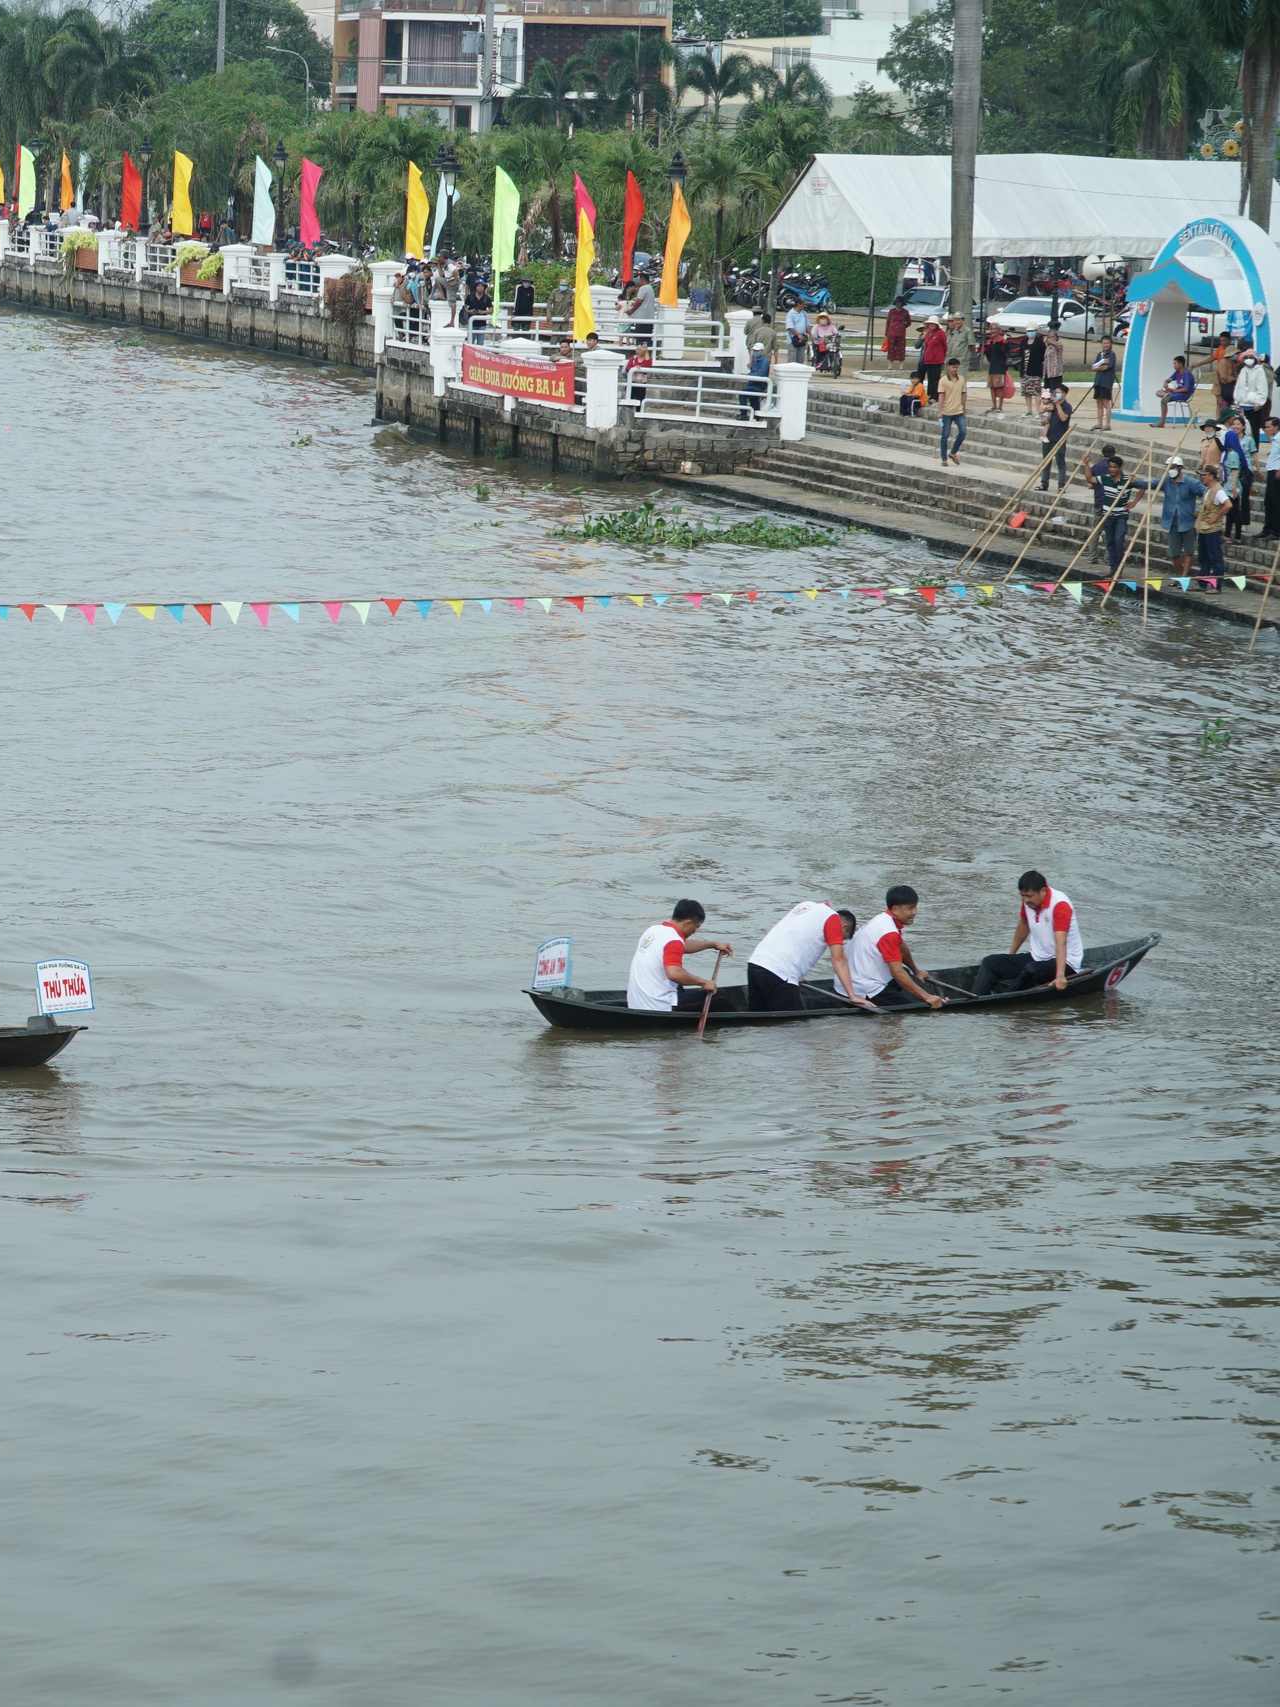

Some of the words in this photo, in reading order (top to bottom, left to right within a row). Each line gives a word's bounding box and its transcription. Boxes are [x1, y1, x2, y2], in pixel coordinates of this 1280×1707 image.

[469, 361, 485, 383] GIẢI
[485, 368, 500, 387] ĐUA
[536, 378, 550, 396] BA
[551, 377, 566, 398] LÁ
[43, 972, 62, 999] THỦ
[62, 972, 87, 997] THỪA
